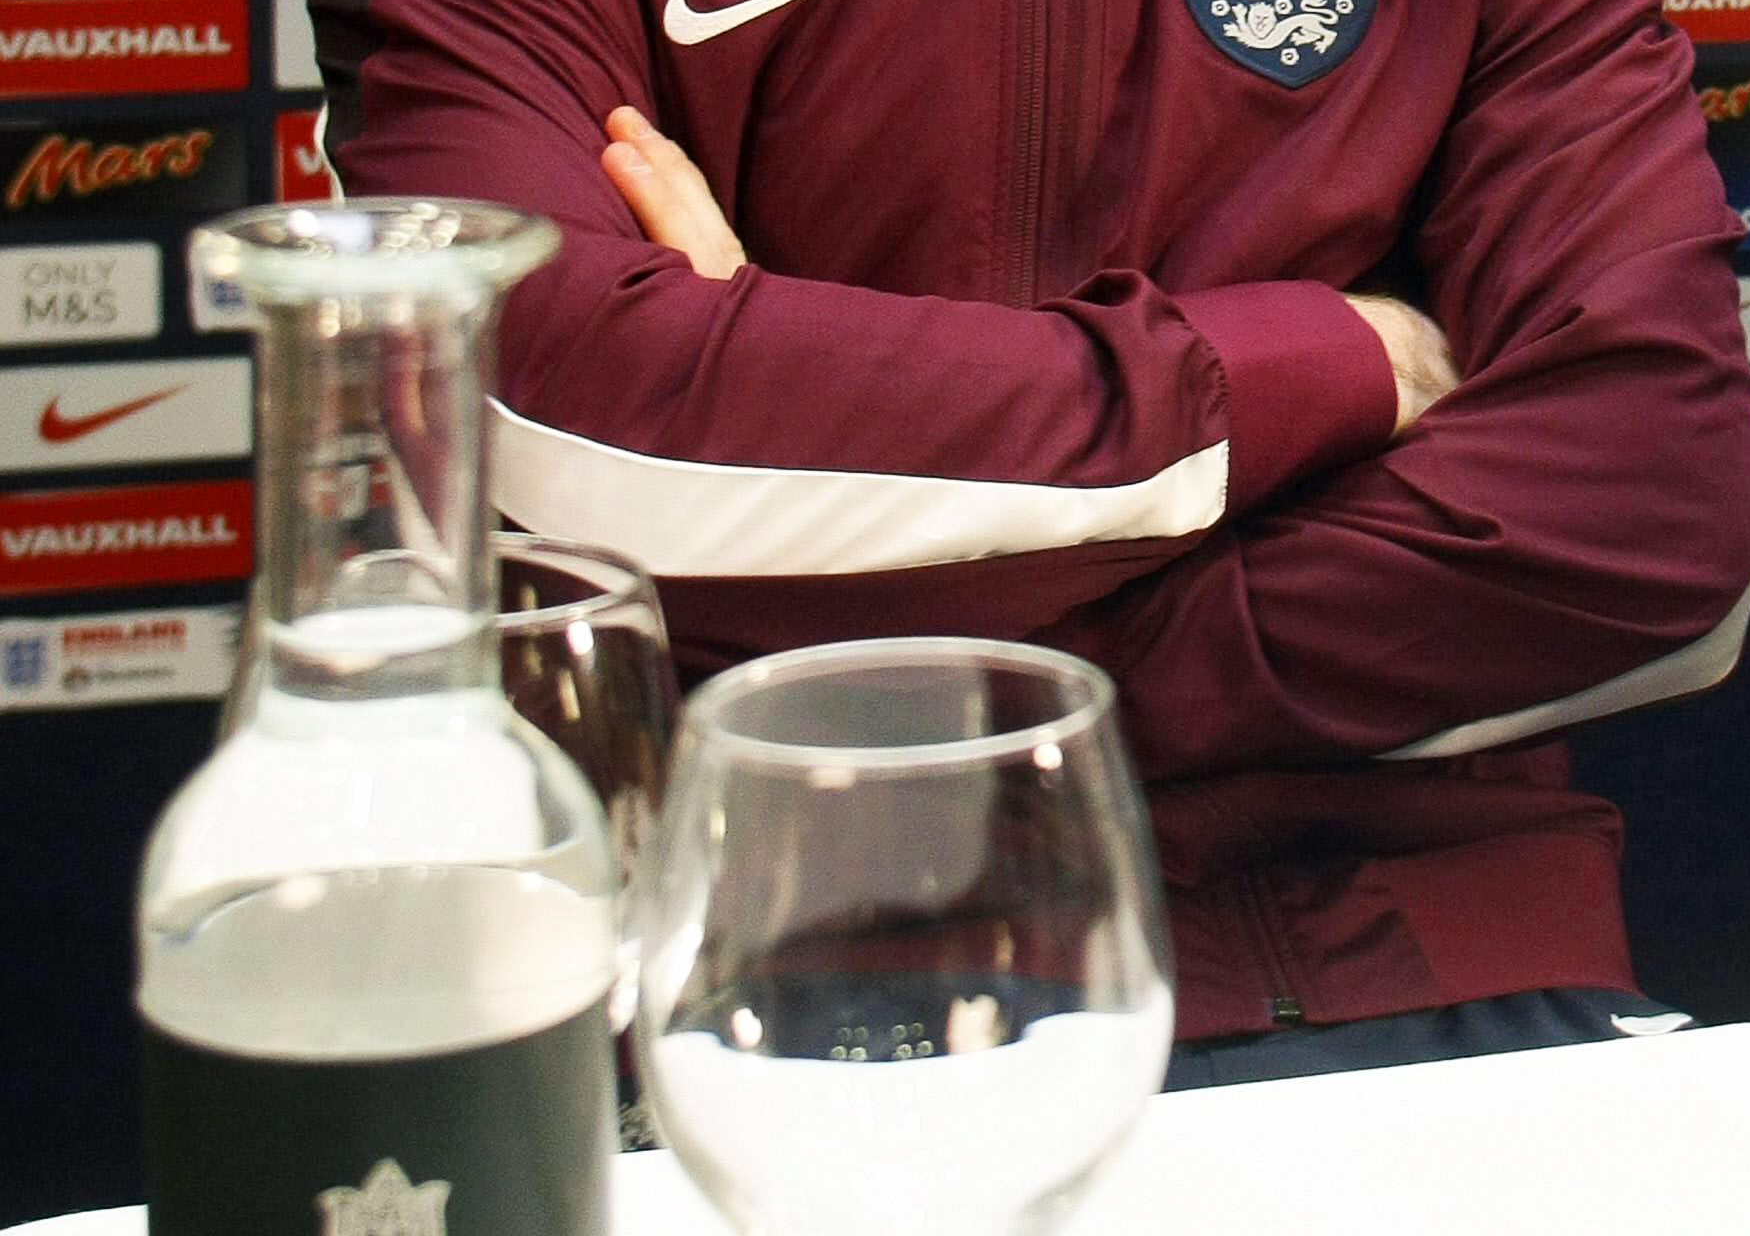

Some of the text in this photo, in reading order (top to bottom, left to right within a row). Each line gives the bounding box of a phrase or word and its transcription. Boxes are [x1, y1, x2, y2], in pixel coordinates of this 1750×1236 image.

[0, 24, 231, 59] VAUXHALL
[8, 129, 214, 209] Mars
[22, 261, 118, 287] ONLY
[23, 290, 118, 324] M&S
[3, 517, 236, 557] VAUXHALL
